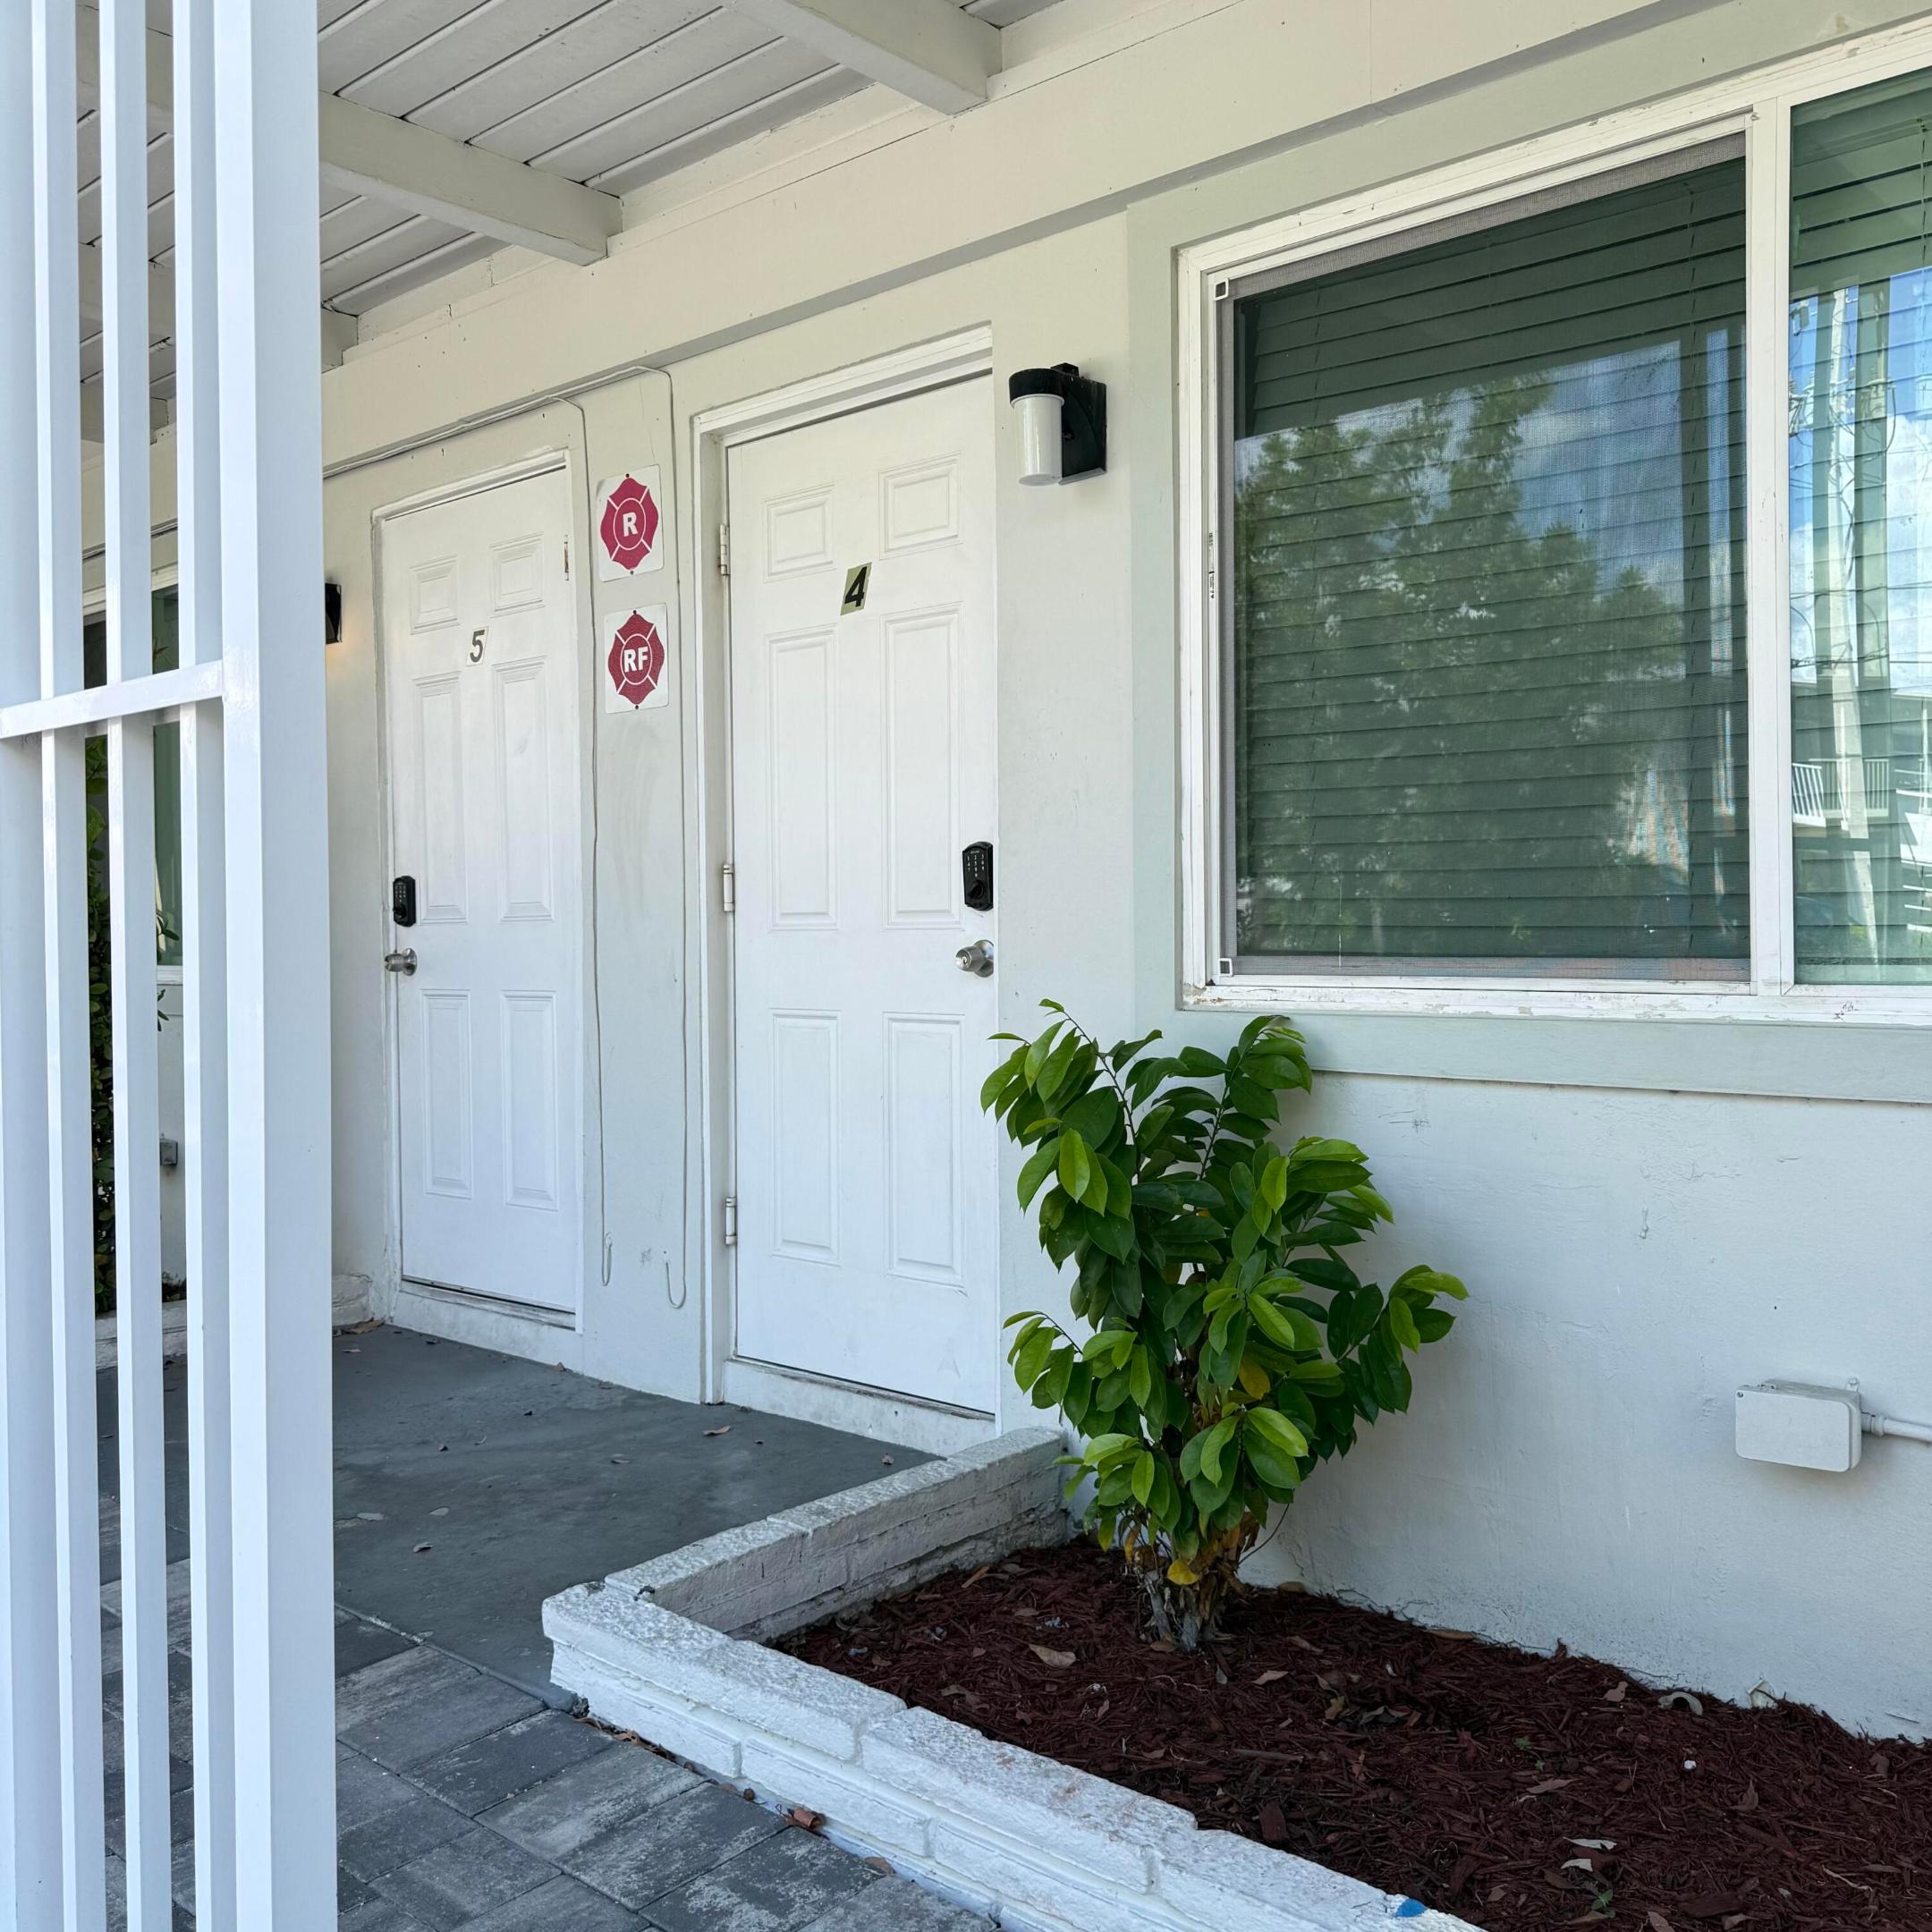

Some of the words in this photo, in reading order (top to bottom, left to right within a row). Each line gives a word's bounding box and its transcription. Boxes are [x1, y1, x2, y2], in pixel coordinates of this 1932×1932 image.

[623, 512, 638, 538] R
[843, 565, 868, 607] 4
[470, 629, 486, 663] 5
[623, 646, 648, 673] RF
